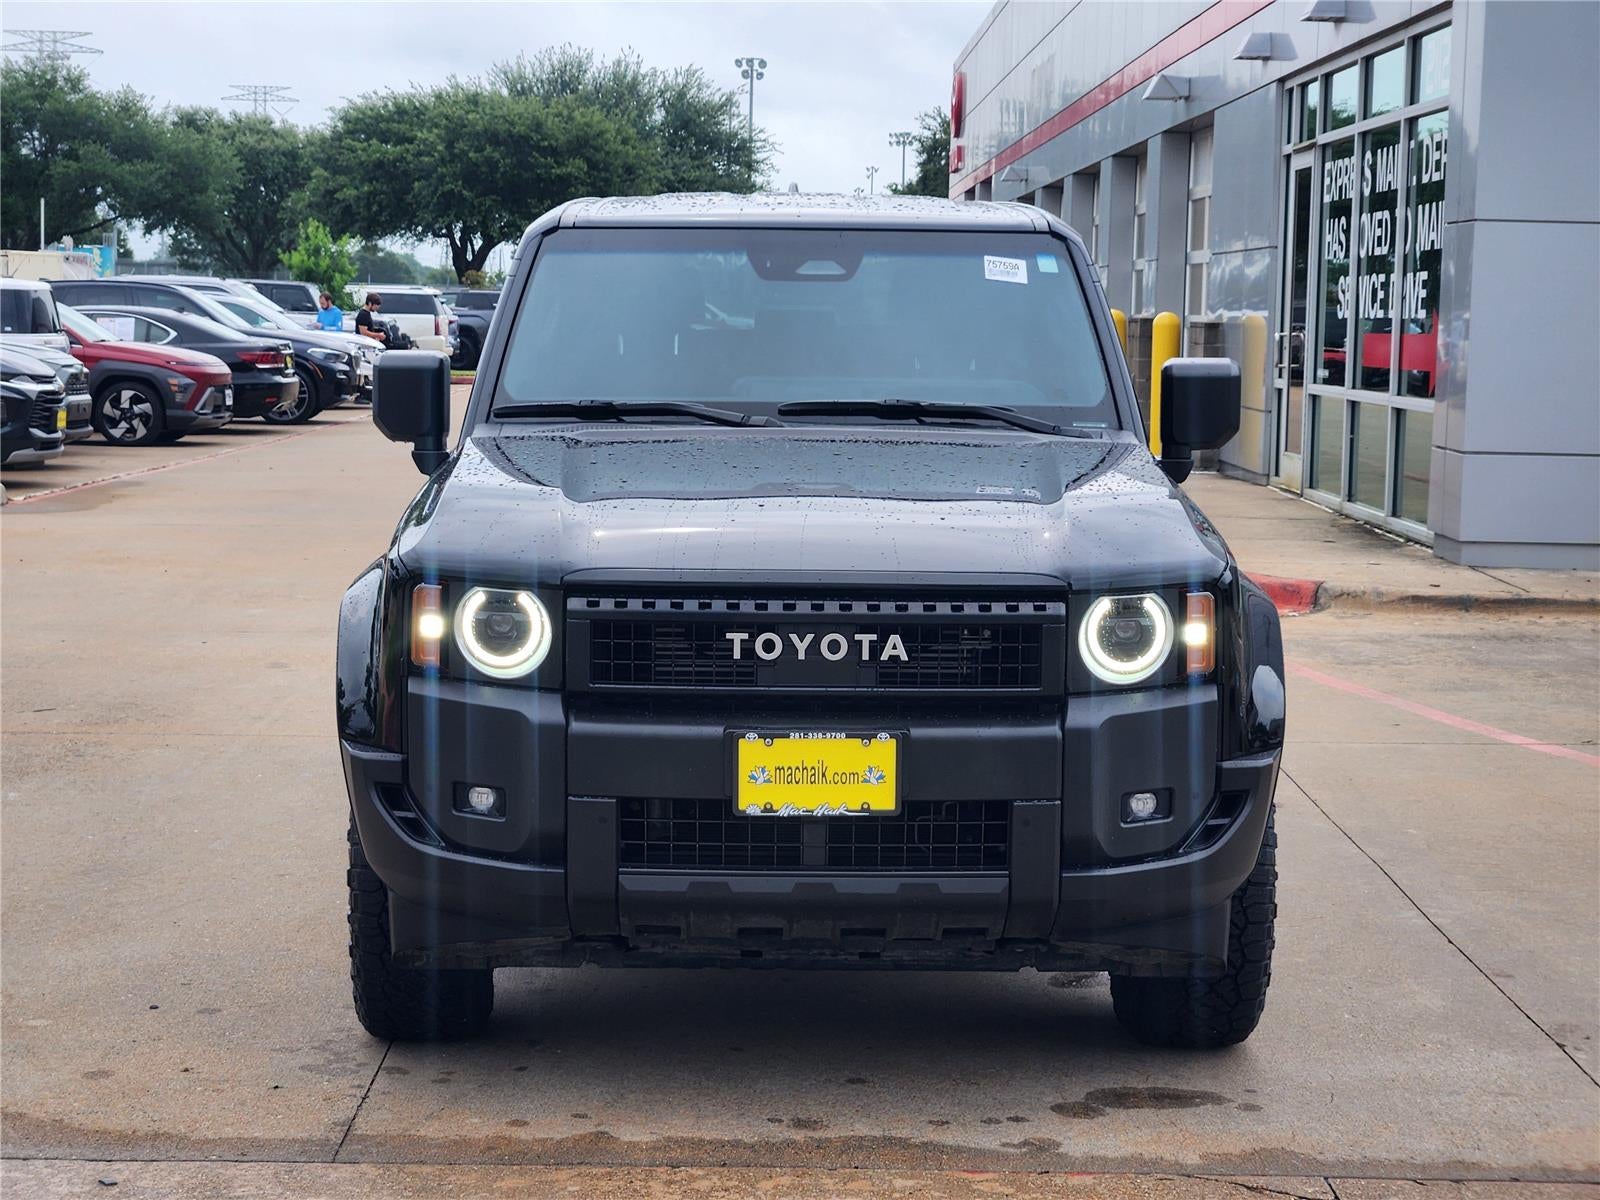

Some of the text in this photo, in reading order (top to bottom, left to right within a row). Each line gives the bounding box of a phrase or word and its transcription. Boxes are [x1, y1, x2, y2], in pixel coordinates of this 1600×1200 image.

[1323, 150, 1373, 204] EXPRES
[1325, 216, 1347, 261] HAS
[1359, 209, 1391, 258] OVED
[1417, 200, 1445, 252] MAI
[1337, 272, 1385, 319] SEVICE
[725, 632, 909, 661] TOYOTA
[774, 759, 860, 785] machaik.com
